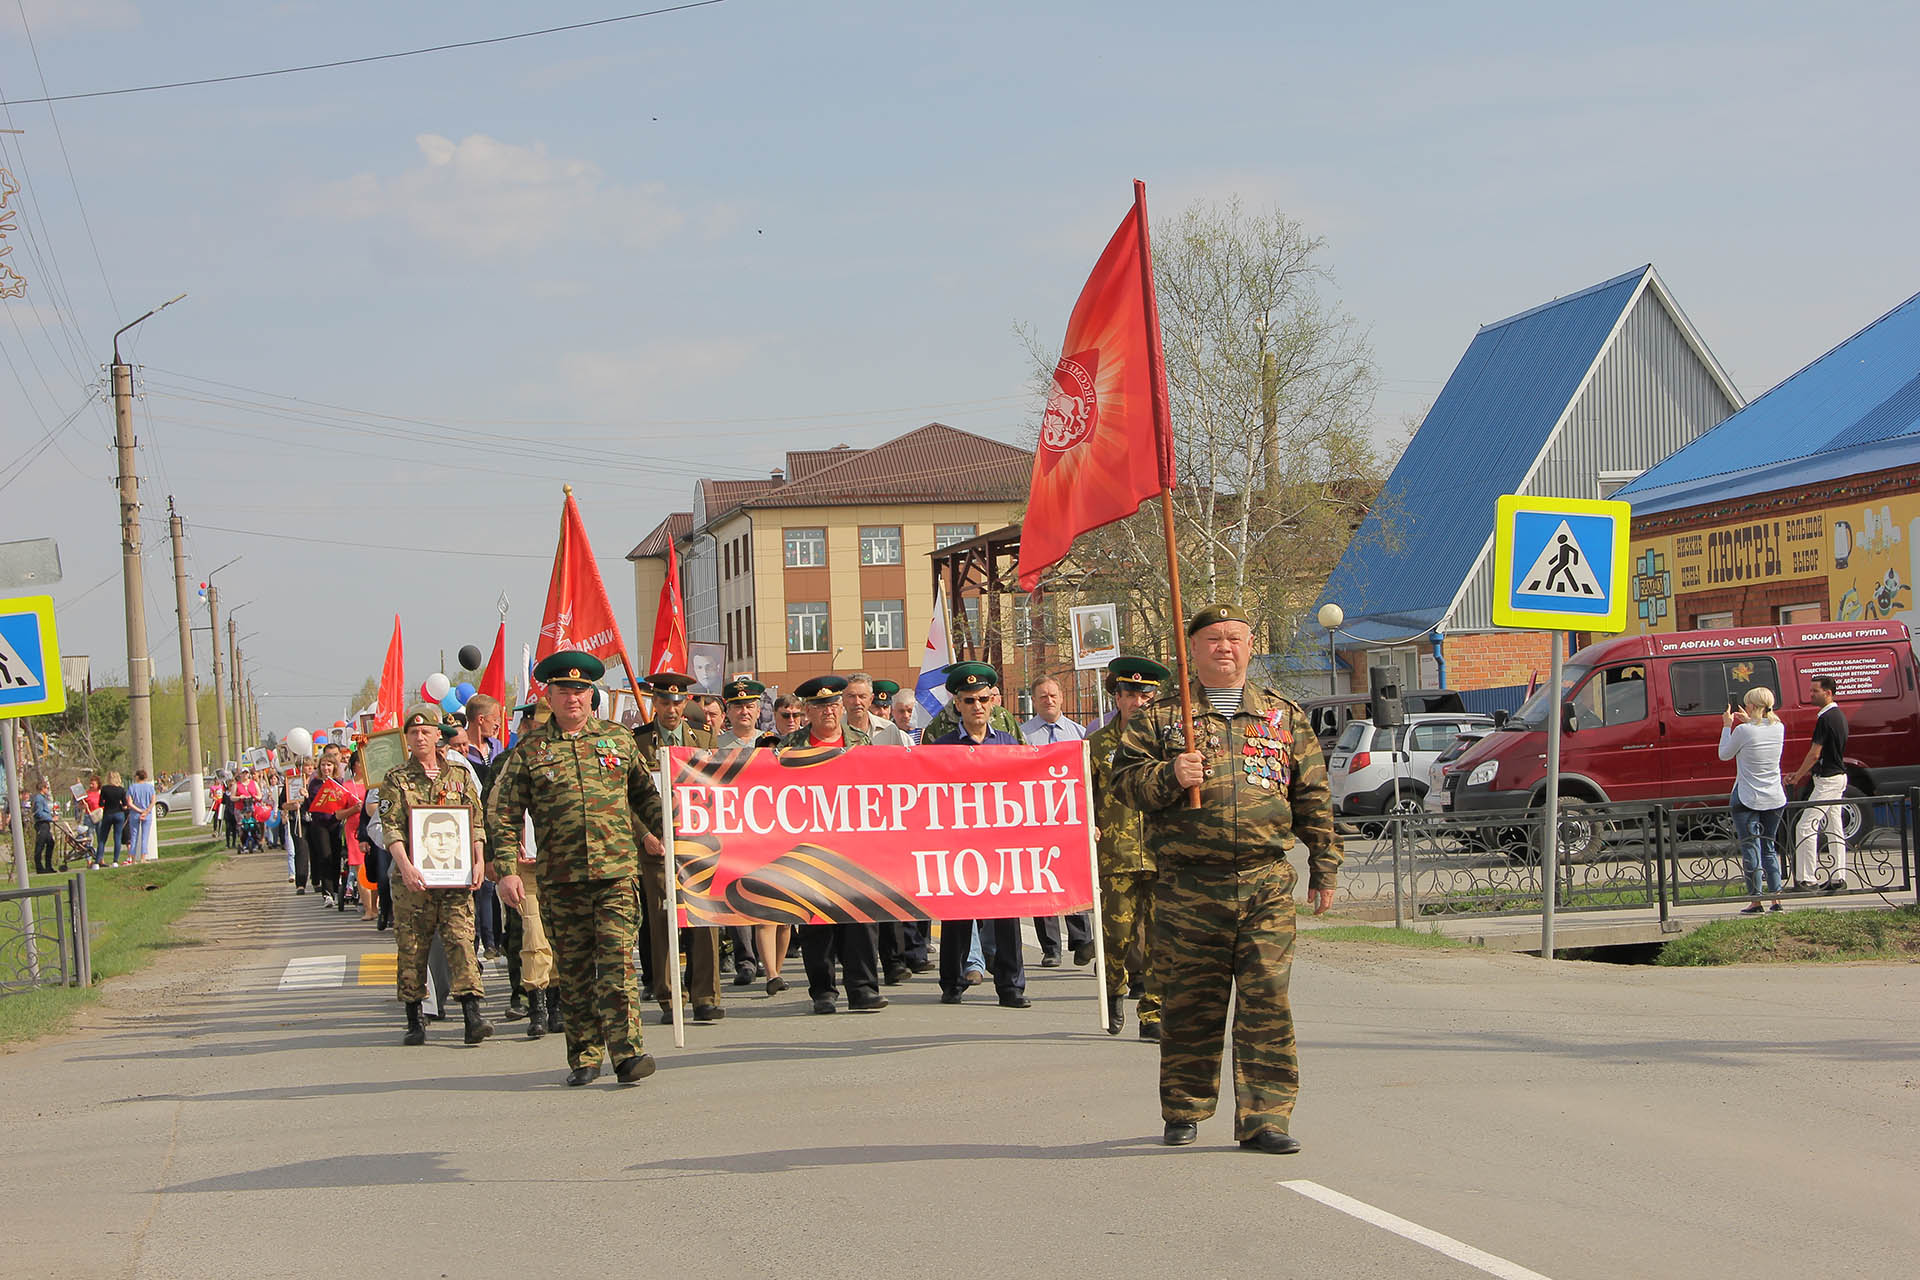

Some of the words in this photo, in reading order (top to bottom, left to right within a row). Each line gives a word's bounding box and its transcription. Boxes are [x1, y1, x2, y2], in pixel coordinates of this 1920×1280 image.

[1786, 515, 1823, 542] БОЛЬШОЙ
[1676, 535, 1702, 558] НИЗКИЕ
[1707, 522, 1782, 584] ЛЮСТРЫ
[1793, 548, 1819, 573] ВЫБОР
[1681, 565, 1701, 588] ЦЕНЫ
[864, 620, 889, 635] МЫ
[1801, 631, 1853, 641] ВОКАЛЬНАЯ
[1855, 628, 1888, 637] ГРУППА
[1680, 639, 1720, 649] АФГАНА
[1723, 638, 1735, 647] до
[1737, 636, 1772, 646] ЧЕЧНИ
[675, 765, 1082, 837] БЕССМЕРТНЫЙ
[910, 845, 1065, 899] ПОЛК
